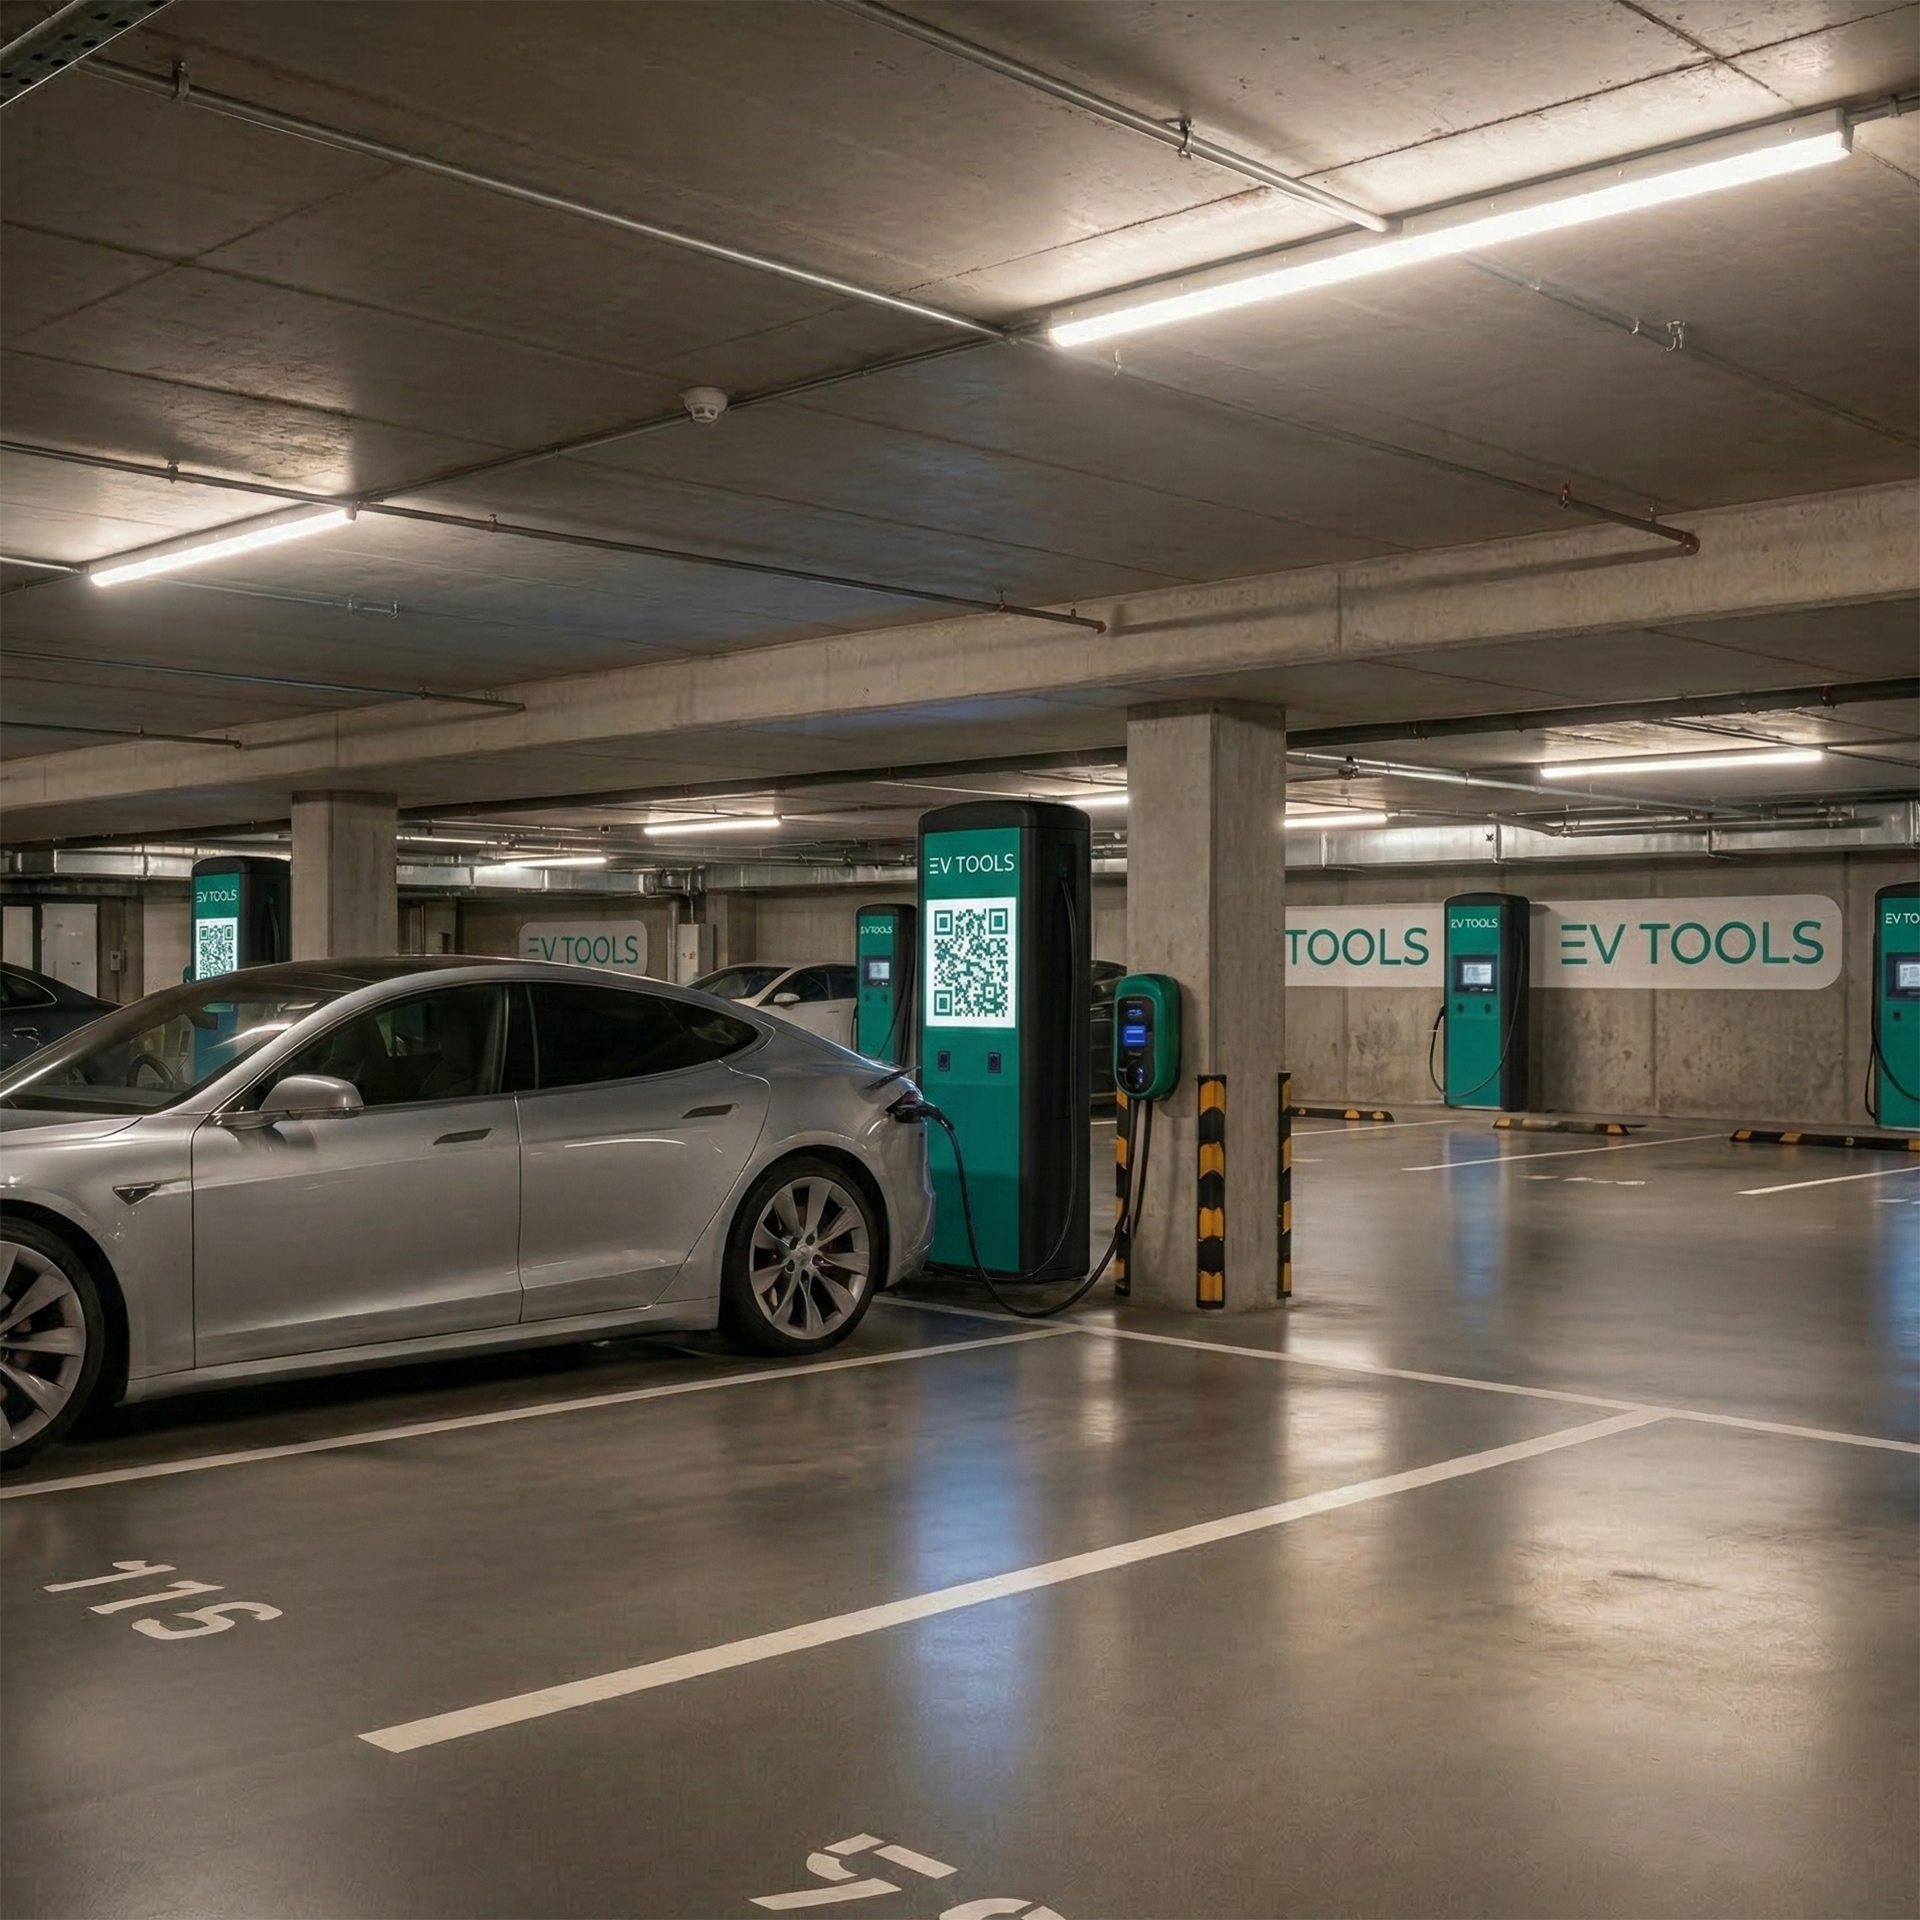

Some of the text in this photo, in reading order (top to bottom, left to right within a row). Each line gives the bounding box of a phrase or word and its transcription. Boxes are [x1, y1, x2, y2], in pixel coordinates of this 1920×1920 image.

[929, 853, 1015, 875] EV TOOLS
[209, 889, 238, 902] TOOLS
[1466, 918, 1498, 929] TOOLS
[1885, 912, 1901, 924] EV
[561, 935, 639, 965] TOOLS
[1285, 927, 1430, 966] TOOLS
[1561, 920, 1825, 965] EV TOOLS
